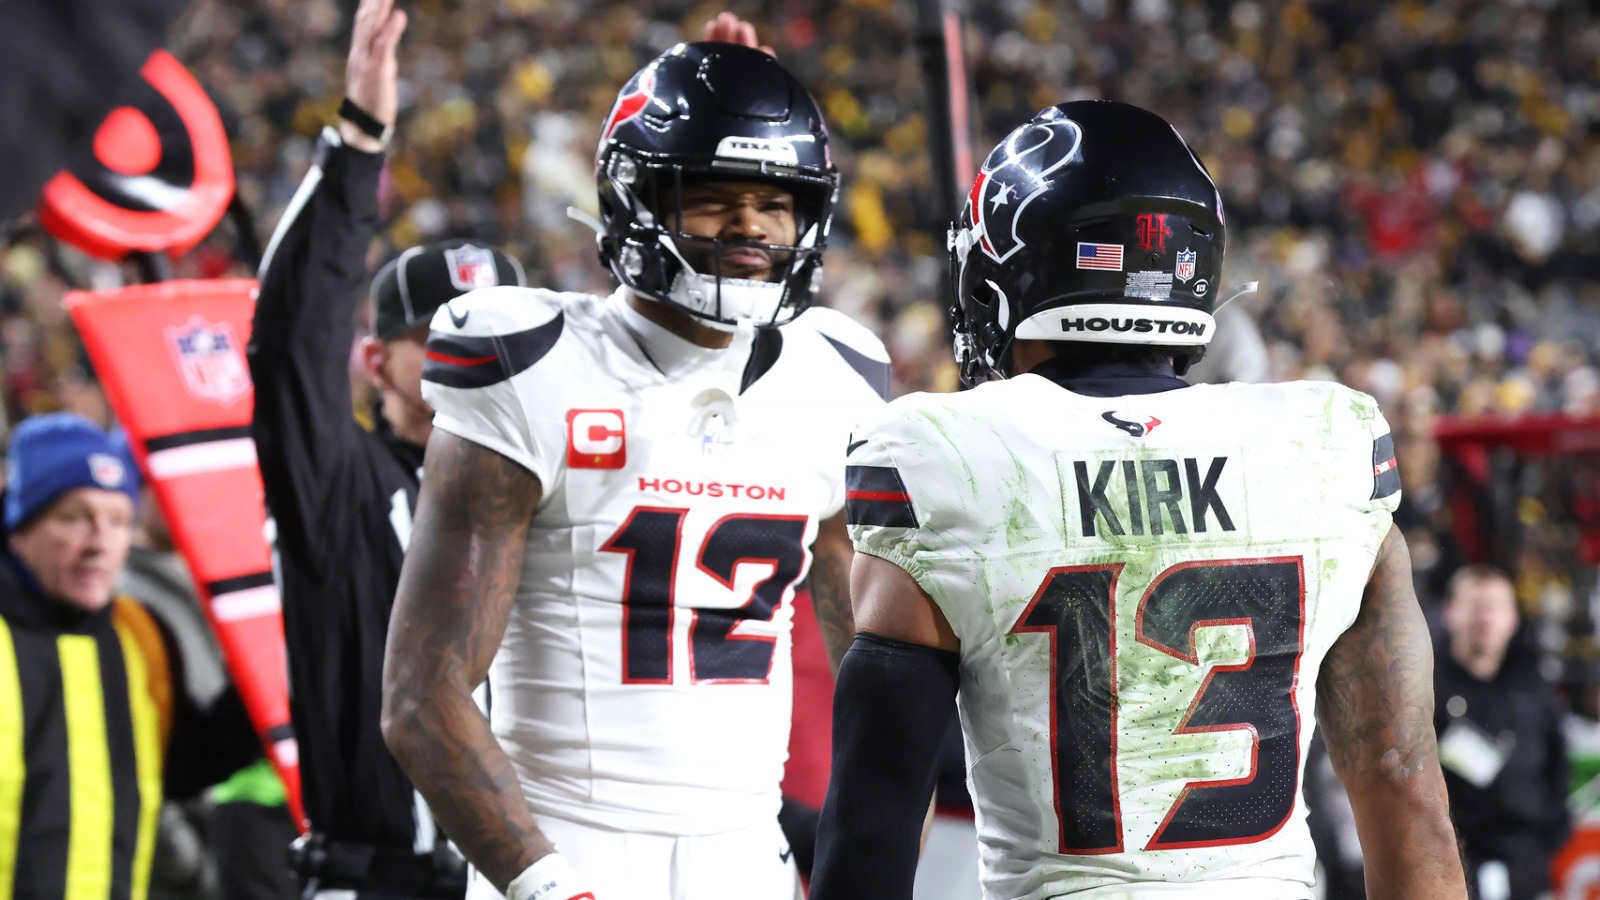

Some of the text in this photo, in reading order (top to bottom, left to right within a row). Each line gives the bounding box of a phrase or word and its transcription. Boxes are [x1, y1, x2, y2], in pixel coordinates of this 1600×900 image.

[1178, 263, 1193, 278] NFL
[1061, 317, 1207, 337] HOUSTON
[572, 411, 624, 455] C
[638, 477, 786, 501] HOUSTON
[1073, 456, 1236, 537] KIRK
[597, 506, 809, 686] 12
[1006, 555, 1305, 855] 13
